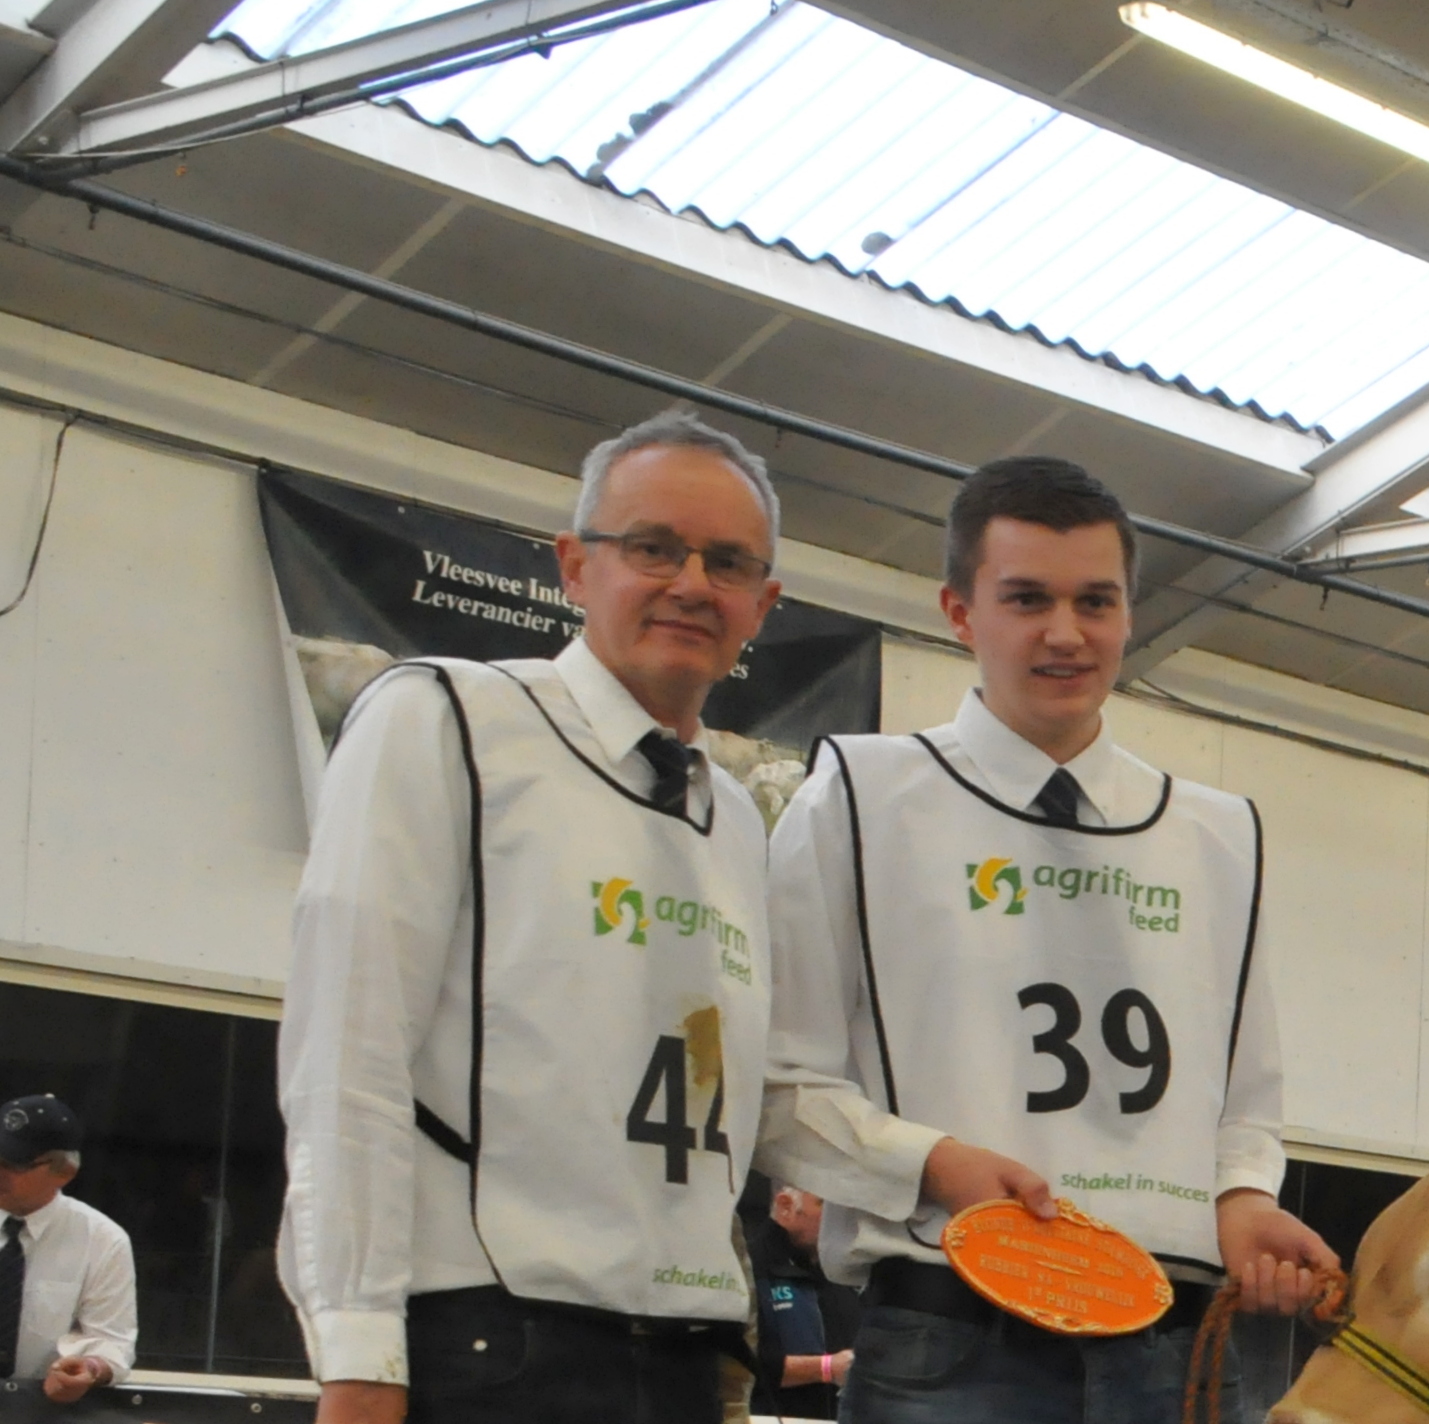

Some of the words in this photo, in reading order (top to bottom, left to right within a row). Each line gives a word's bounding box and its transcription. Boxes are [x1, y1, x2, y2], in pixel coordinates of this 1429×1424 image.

[422, 550, 522, 596] Vleesvee
[412, 579, 556, 633] Leverancier
[1033, 864, 1182, 910] agrifirm
[1128, 904, 1180, 933] feed
[1016, 981, 1172, 1115] 39
[1060, 1172, 1132, 1191] schakel
[1136, 1173, 1154, 1191] in
[1158, 1180, 1210, 1203] succes
[652, 1265, 725, 1290] schakel
